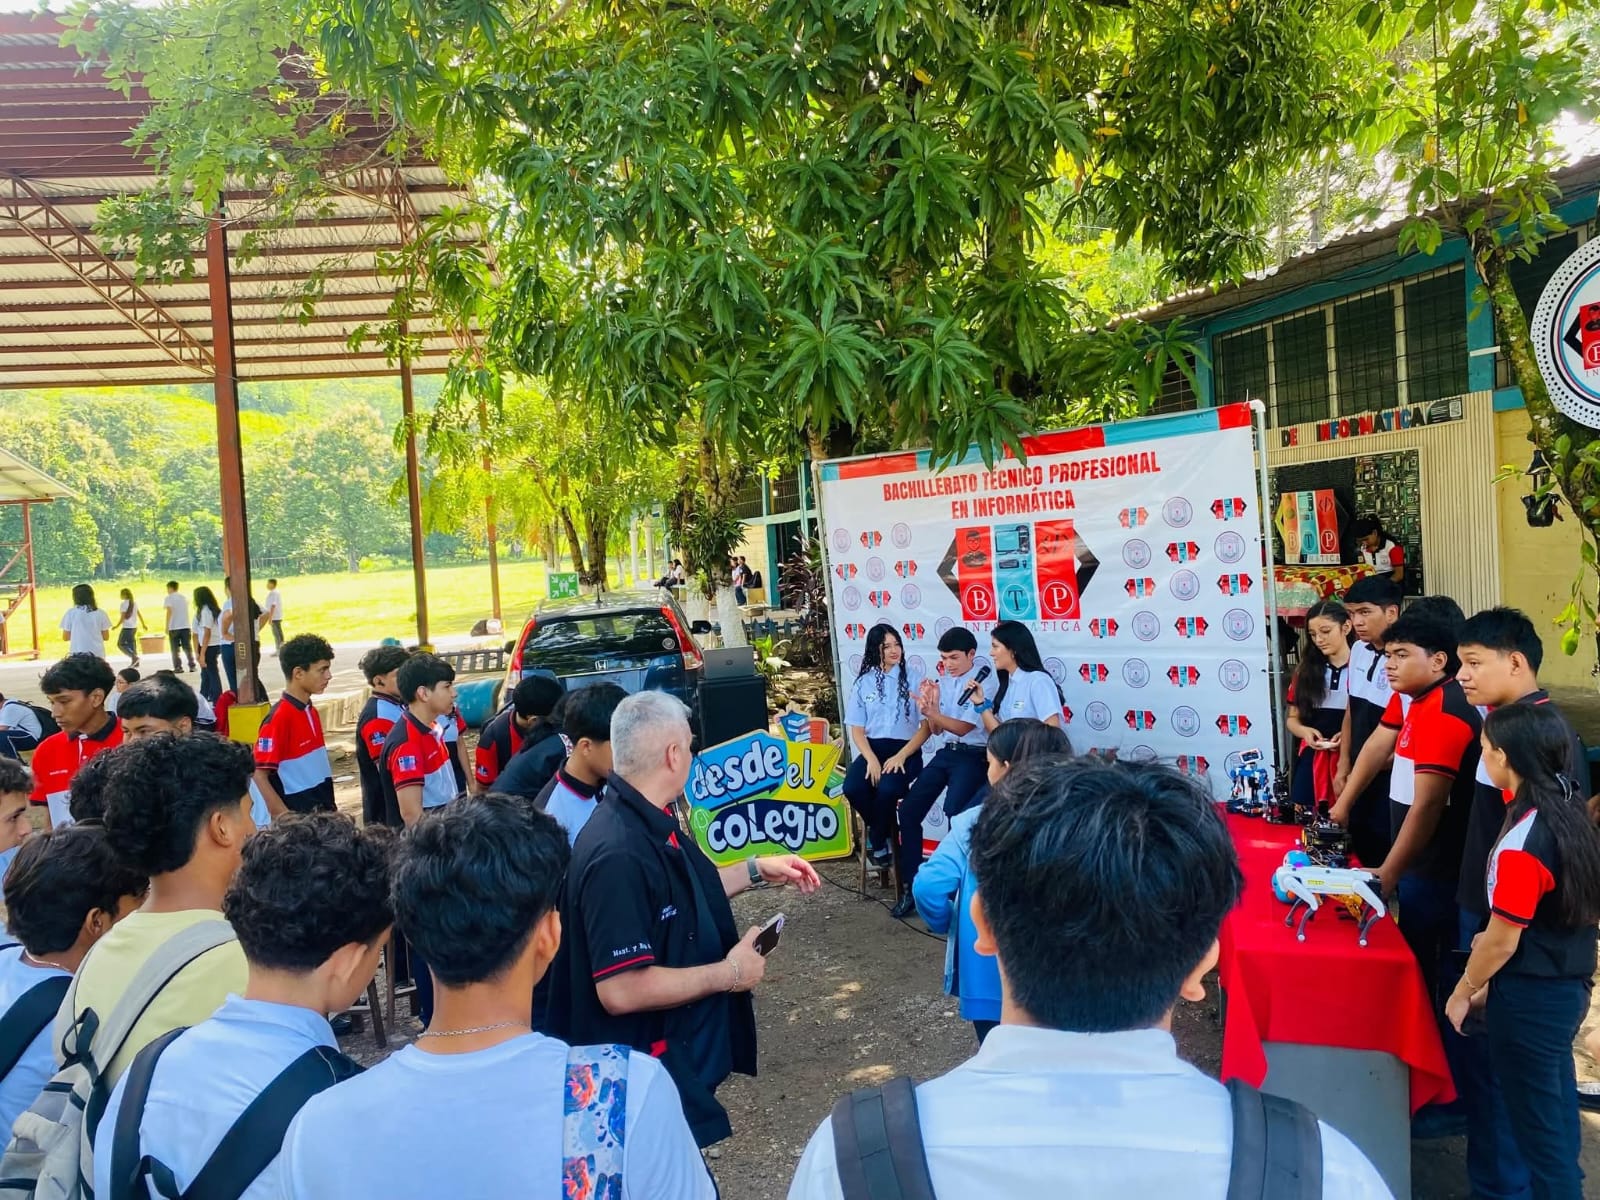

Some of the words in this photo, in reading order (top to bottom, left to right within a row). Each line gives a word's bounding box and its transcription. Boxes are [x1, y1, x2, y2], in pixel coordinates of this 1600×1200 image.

[1281, 428, 1298, 447] DE
[883, 473, 978, 501] BACHILLERATO
[982, 464, 1043, 491] TÉCNICO
[1050, 451, 1161, 483] PROFESIONAL
[951, 501, 969, 520] EN
[973, 487, 1076, 518] INFORMÁTICA
[690, 740, 785, 801] desde
[786, 748, 814, 789] el
